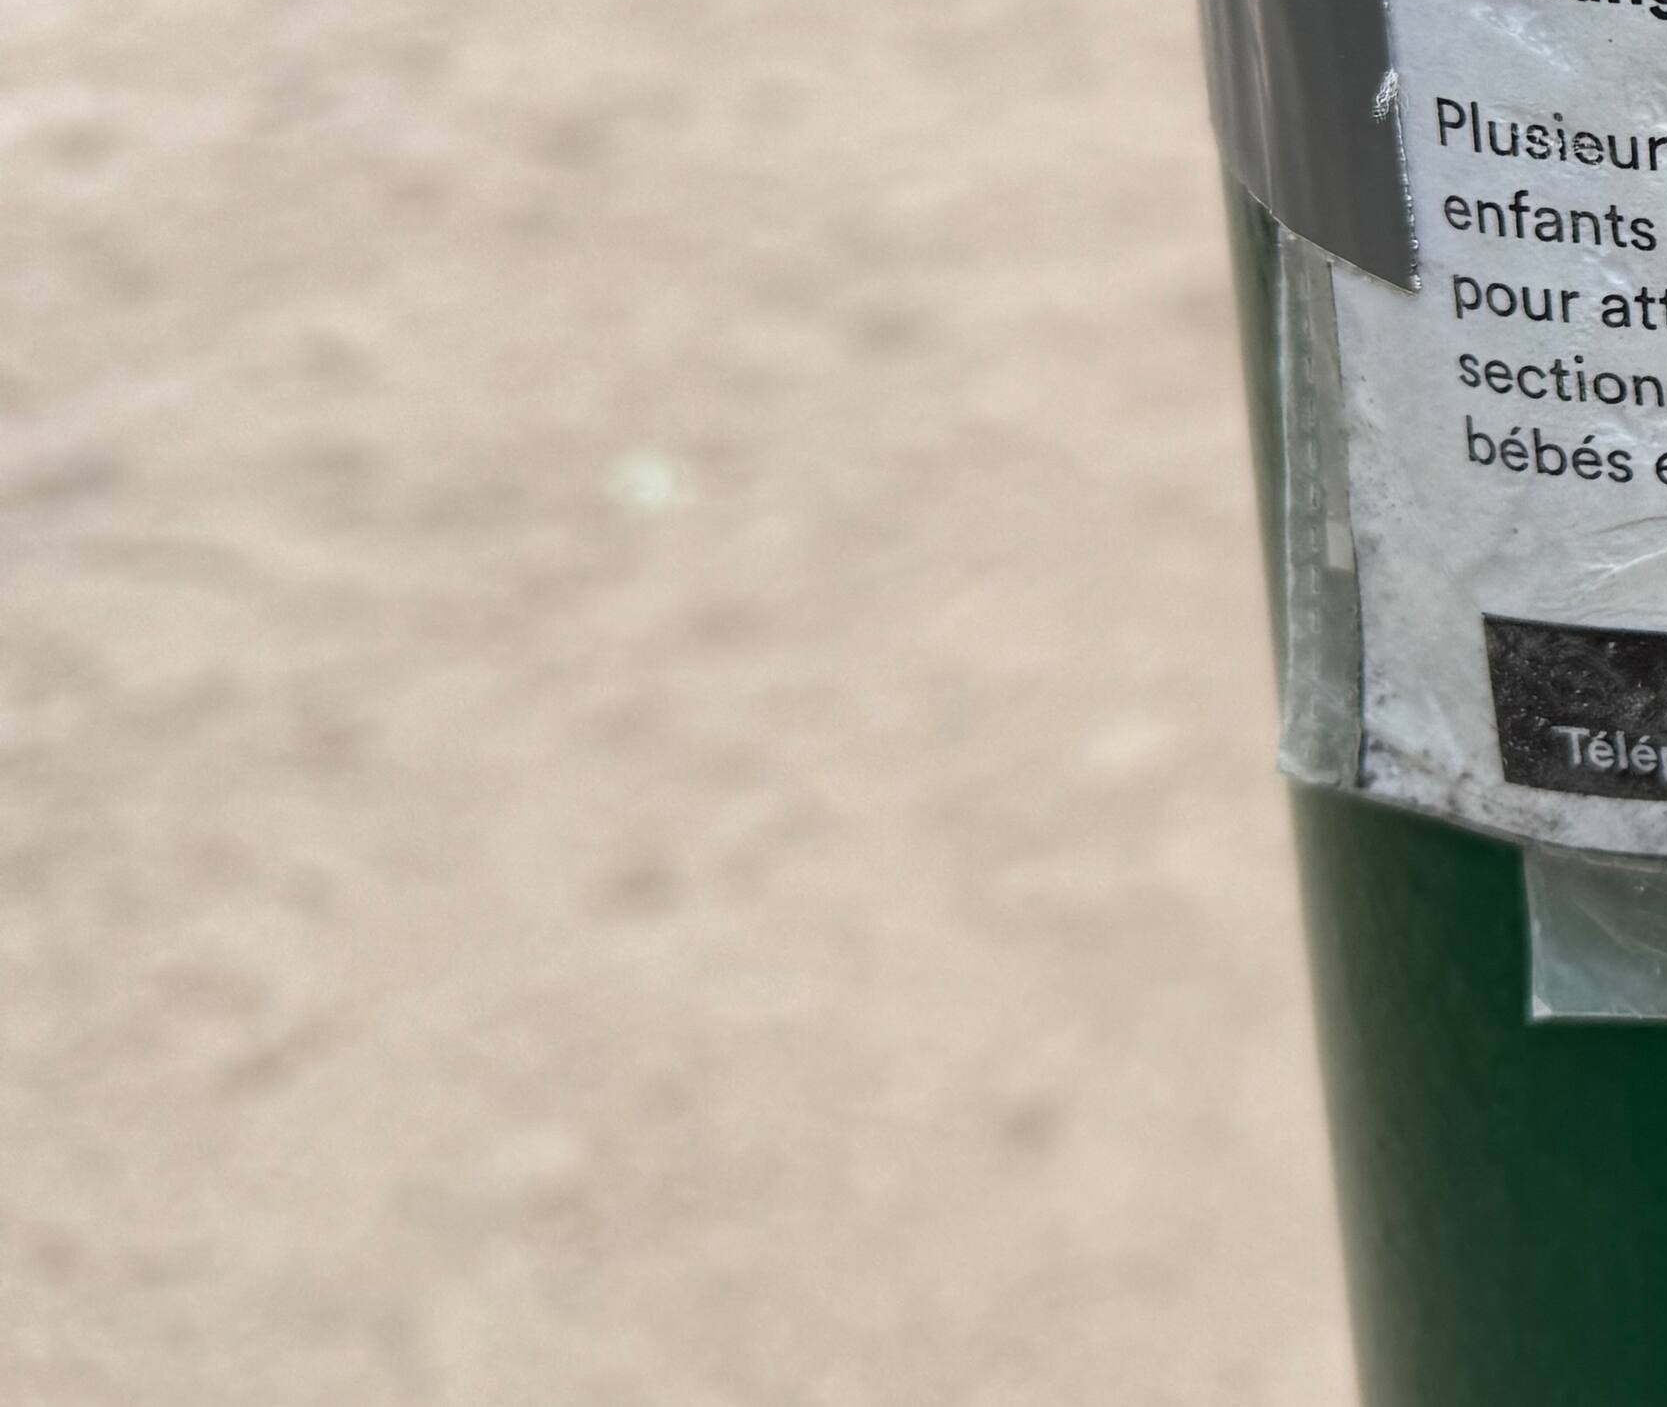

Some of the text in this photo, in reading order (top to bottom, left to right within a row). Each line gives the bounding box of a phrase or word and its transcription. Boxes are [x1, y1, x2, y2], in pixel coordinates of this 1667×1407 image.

[1443, 188, 1657, 253] enfants
[1452, 273, 1581, 322] pour
[1457, 351, 1665, 409] section
[1465, 415, 1633, 488] bébés
